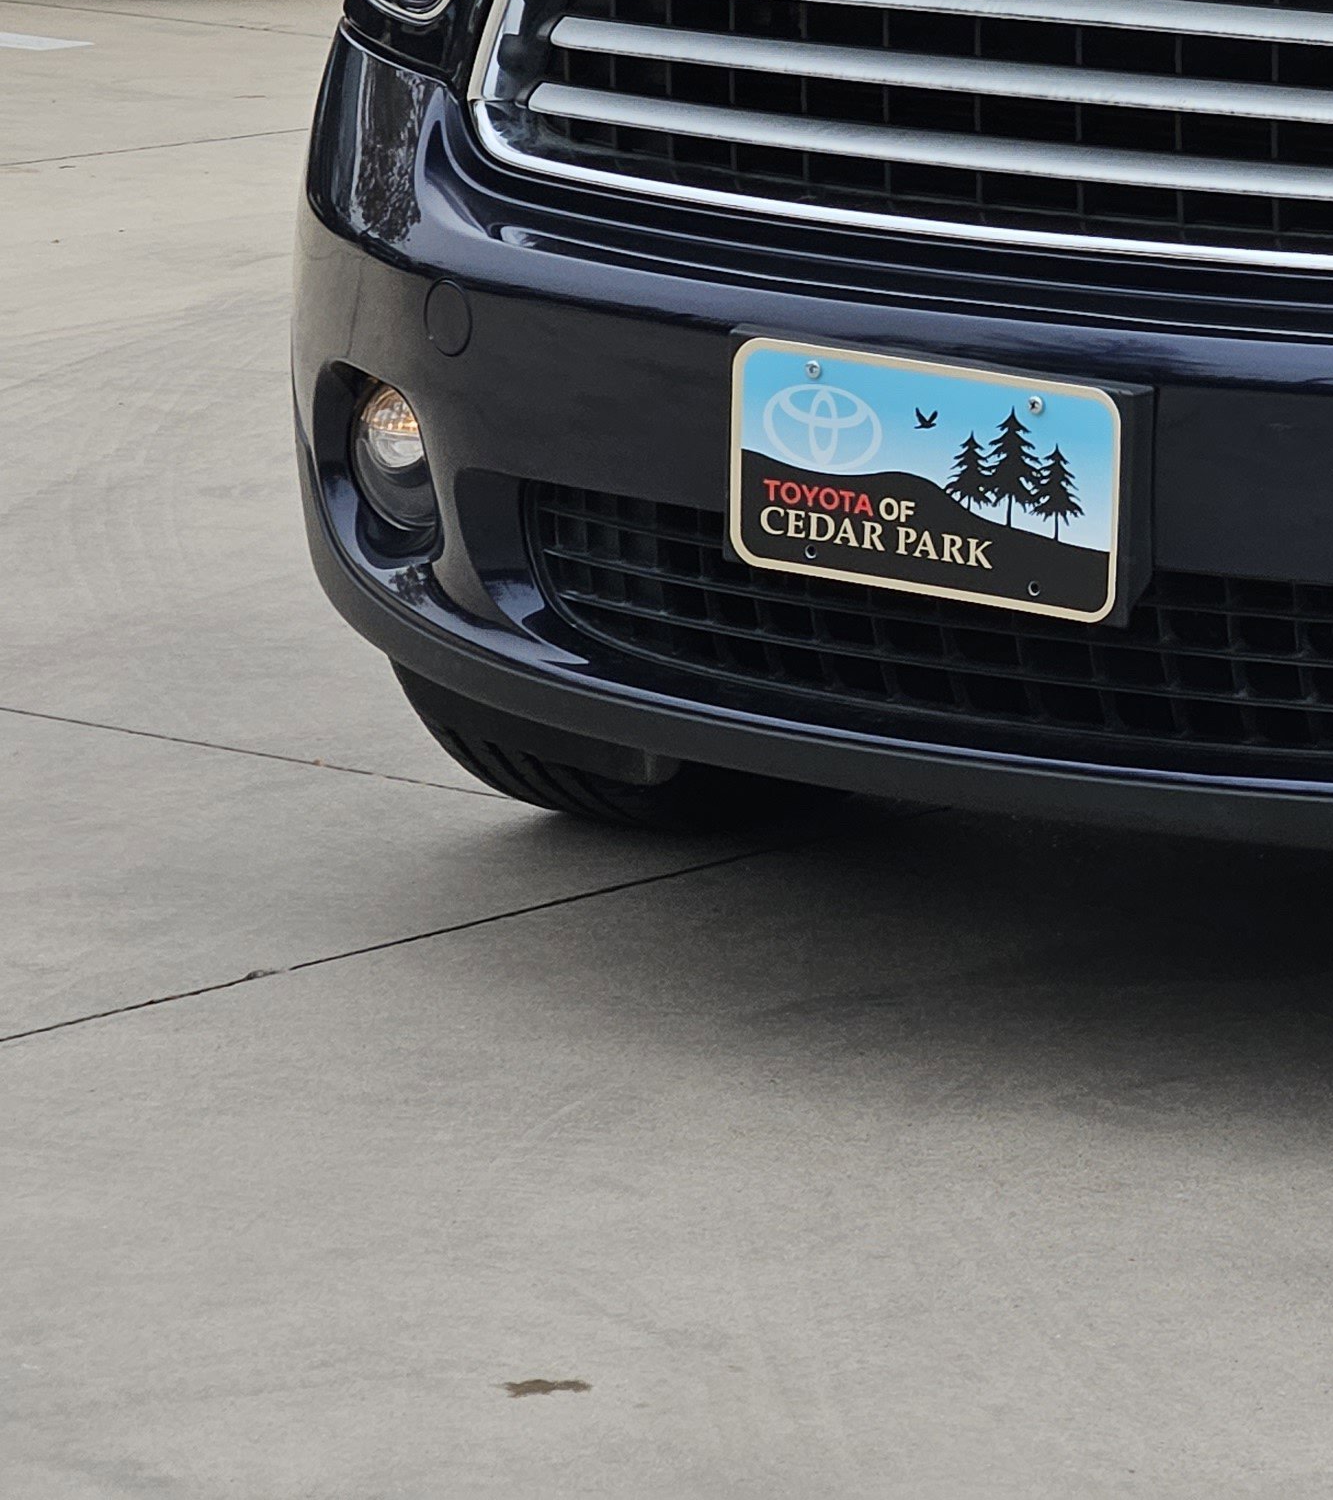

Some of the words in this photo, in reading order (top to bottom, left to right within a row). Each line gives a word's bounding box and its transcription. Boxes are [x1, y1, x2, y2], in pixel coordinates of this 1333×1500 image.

[763, 478, 874, 516] TOYOTA
[879, 498, 916, 522] OF
[760, 507, 885, 552] CEDAR
[896, 526, 993, 569] PARK
